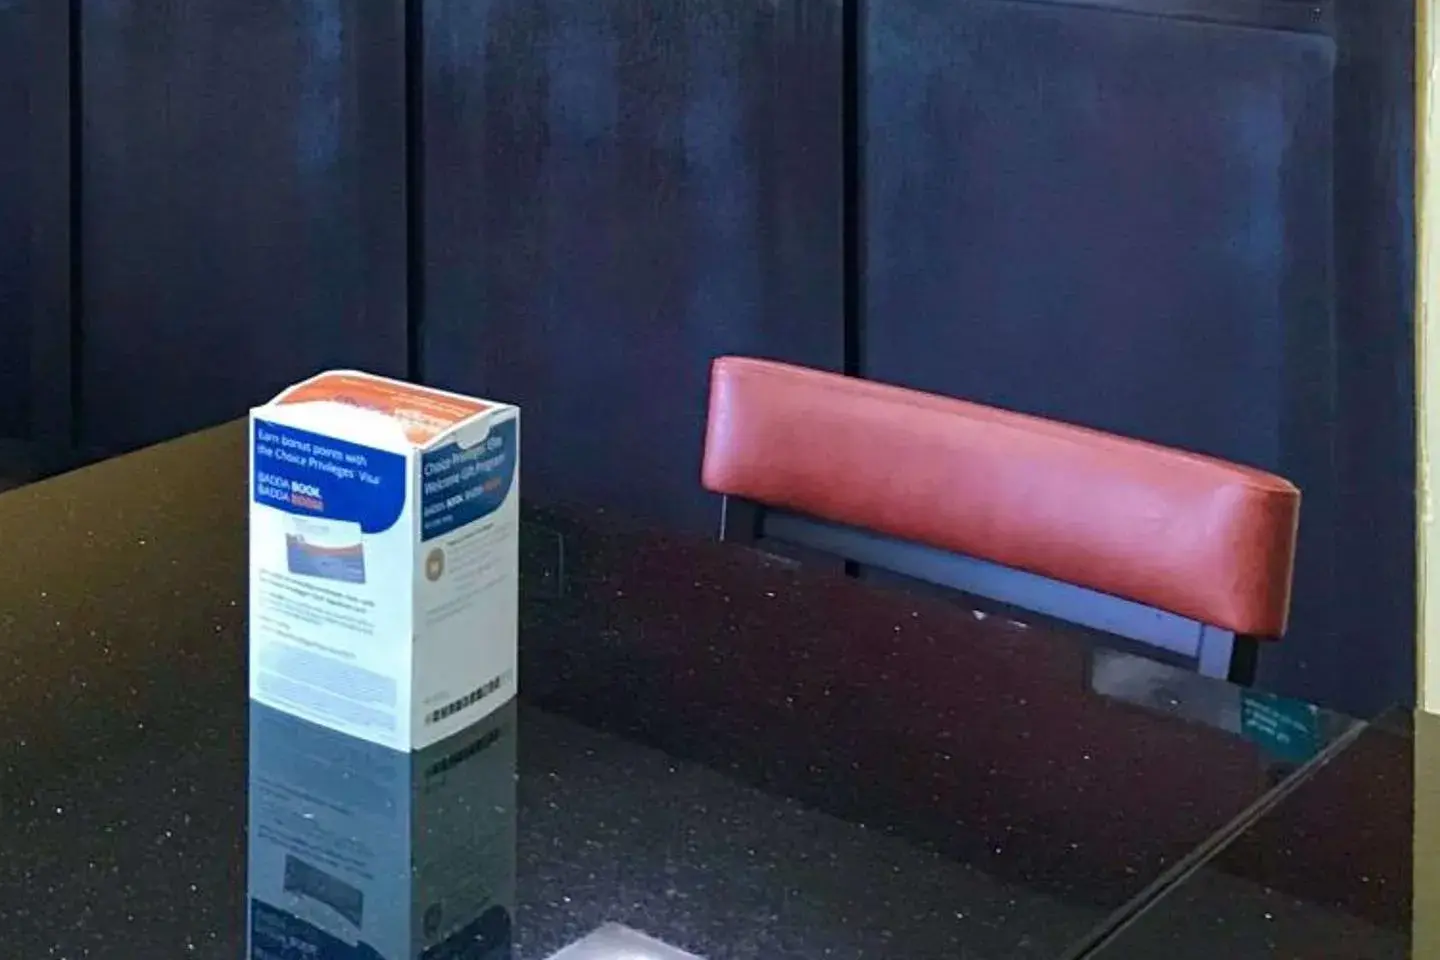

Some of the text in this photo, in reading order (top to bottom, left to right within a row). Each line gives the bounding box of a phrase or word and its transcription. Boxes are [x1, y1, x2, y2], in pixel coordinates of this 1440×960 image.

[257, 444, 273, 458] the
[275, 448, 307, 466] Choice
[258, 428, 368, 467] Earn bonus points with
